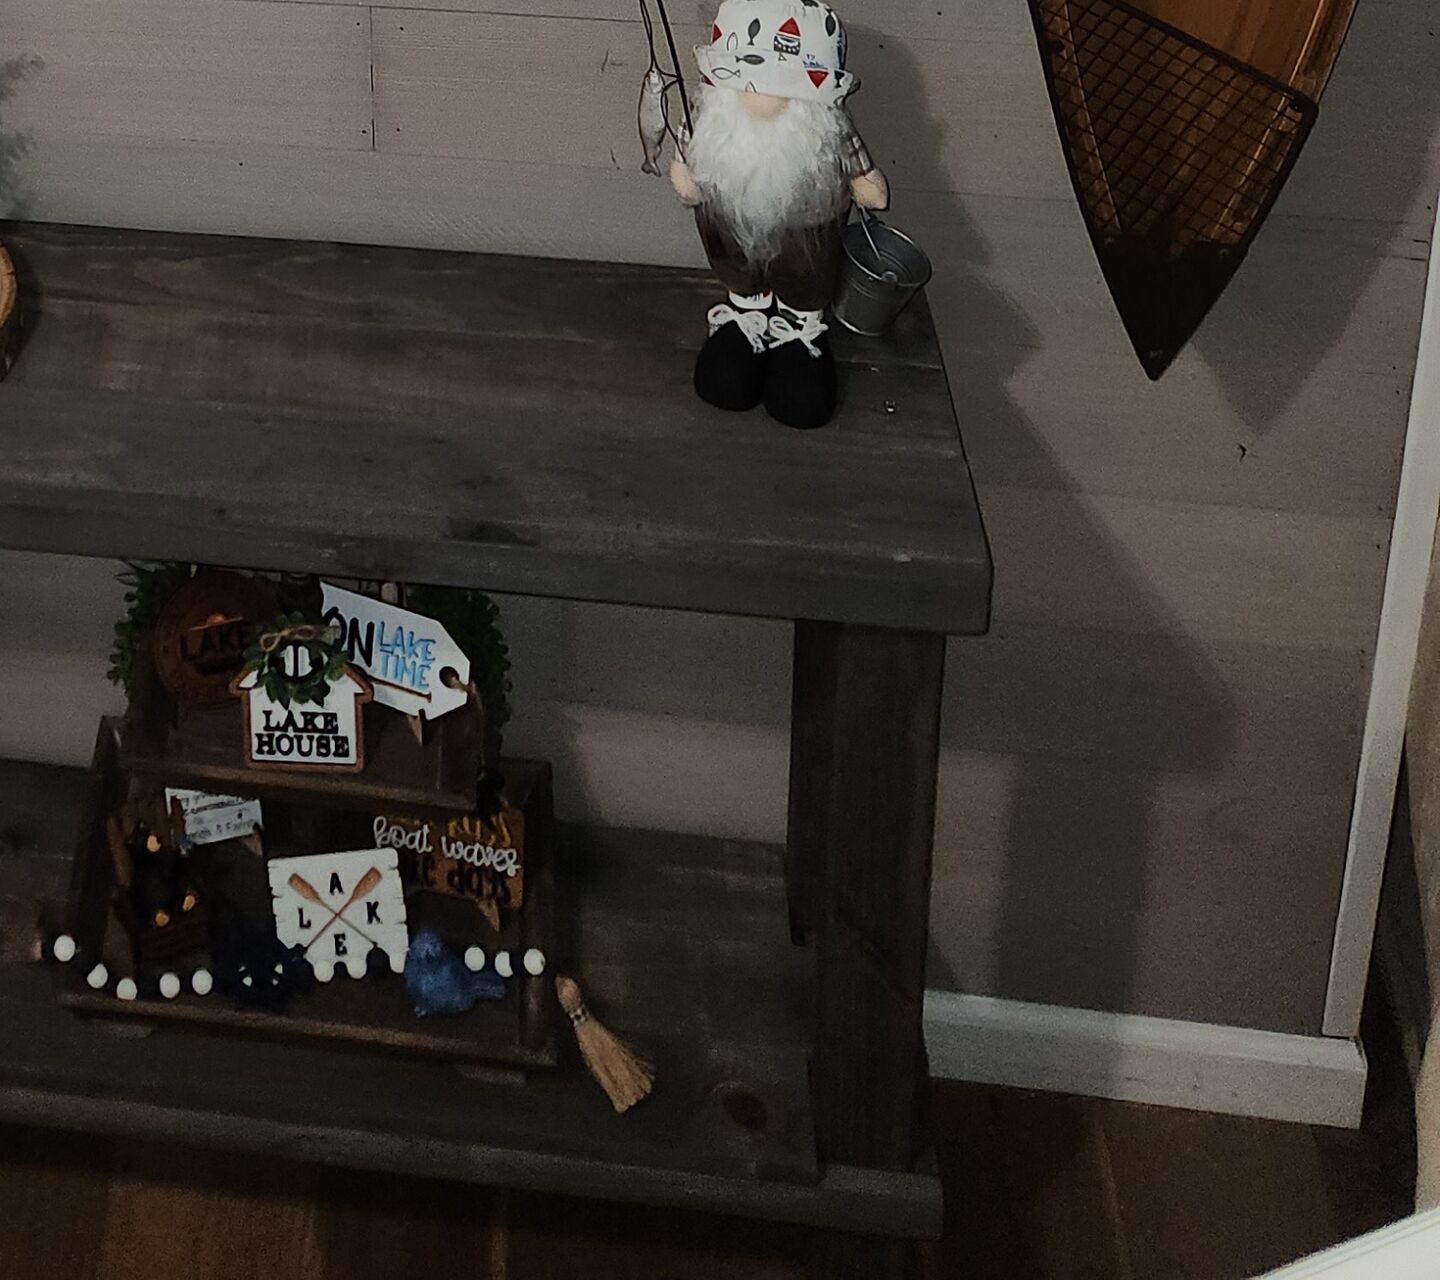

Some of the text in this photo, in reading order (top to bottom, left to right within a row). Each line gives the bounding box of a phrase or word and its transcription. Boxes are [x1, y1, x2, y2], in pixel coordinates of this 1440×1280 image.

[377, 620, 437, 663] LAKE
[379, 648, 432, 689] TIME
[262, 710, 339, 735] LAKE
[254, 732, 350, 759] HOUSE
[372, 815, 434, 855] boat
[440, 835, 522, 878] waves
